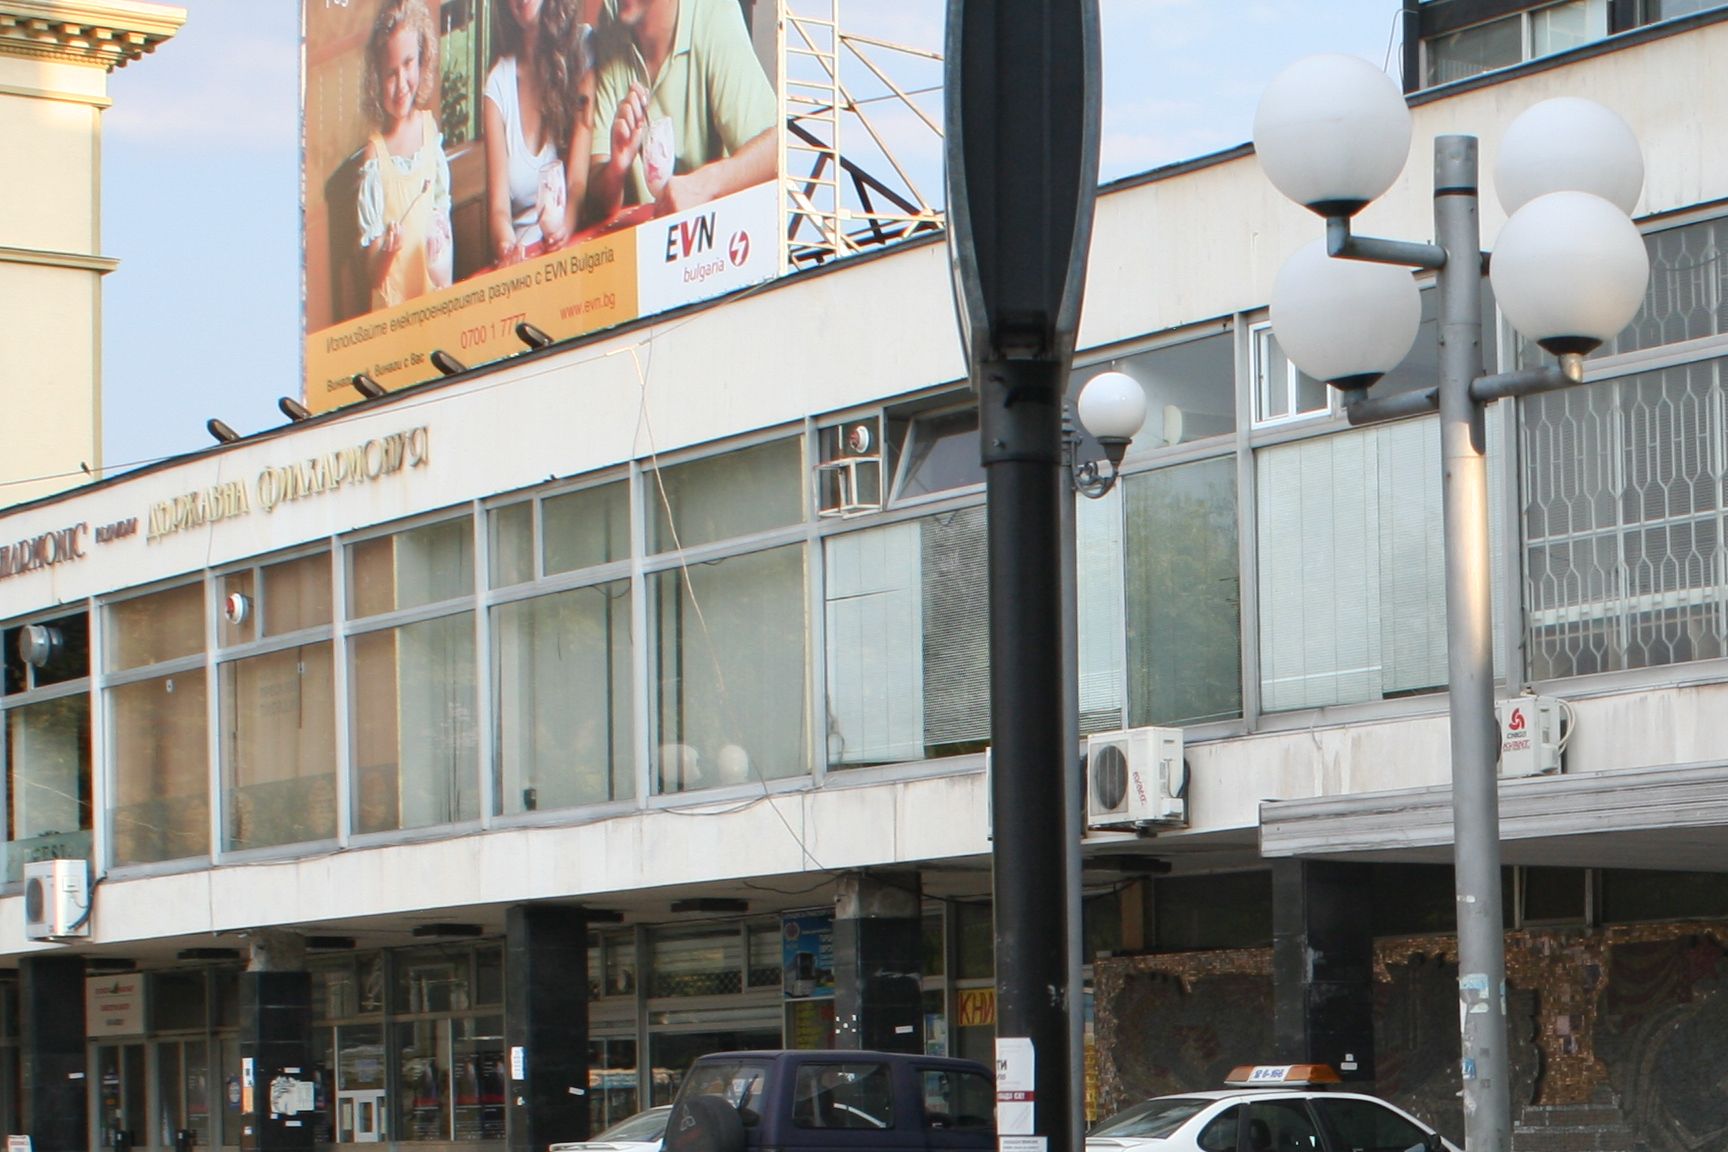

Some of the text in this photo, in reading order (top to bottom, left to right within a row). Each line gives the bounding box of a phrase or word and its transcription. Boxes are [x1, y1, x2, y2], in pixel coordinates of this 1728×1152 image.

[666, 212, 715, 262] EVN
[488, 273, 532, 302] разумно
[545, 261, 568, 283] EVN
[571, 246, 615, 274] Bulgaria
[683, 256, 724, 283] bulgaria
[560, 292, 616, 320] www.evn.bg
[460, 325, 487, 350] 0700
[147, 426, 432, 544] ДЪРЖАВНА ФИЛХАРМОНИЯ
[960, 991, 995, 1025] КНИ
